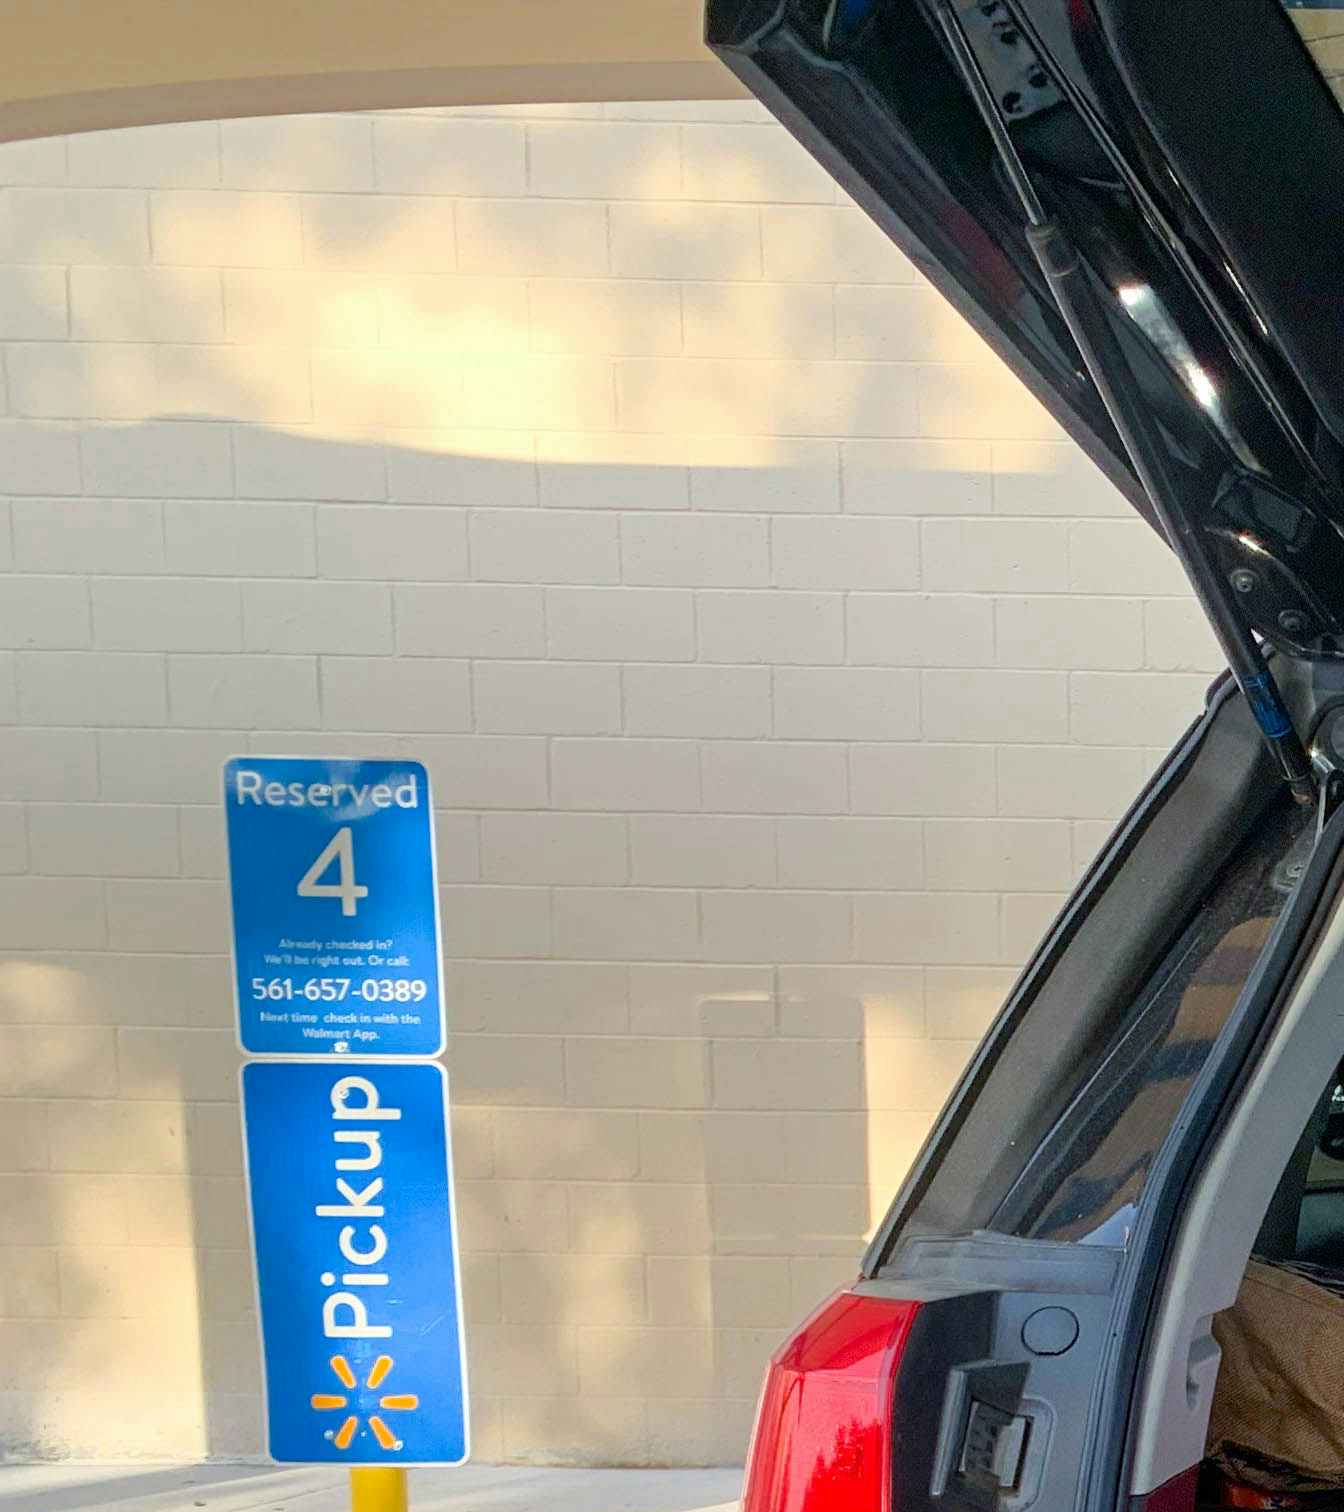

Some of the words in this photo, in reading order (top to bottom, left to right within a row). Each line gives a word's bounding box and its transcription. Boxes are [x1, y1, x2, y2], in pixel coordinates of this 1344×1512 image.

[236, 770, 419, 809] Reserved
[297, 826, 368, 917] 4
[278, 938, 323, 951] Already
[325, 938, 374, 950] checked
[294, 954, 309, 965] be
[311, 954, 339, 967] right
[368, 954, 384, 966] Or
[252, 977, 427, 1002] 561-657-0389
[260, 1012, 288, 1022] Next
[323, 1012, 357, 1024] check
[360, 1013, 371, 1023] in
[373, 1013, 398, 1024] with
[400, 1013, 421, 1025] the
[302, 1027, 351, 1039] Walmart
[353, 1028, 380, 1041] App.
[315, 1075, 402, 1339] Pickup
